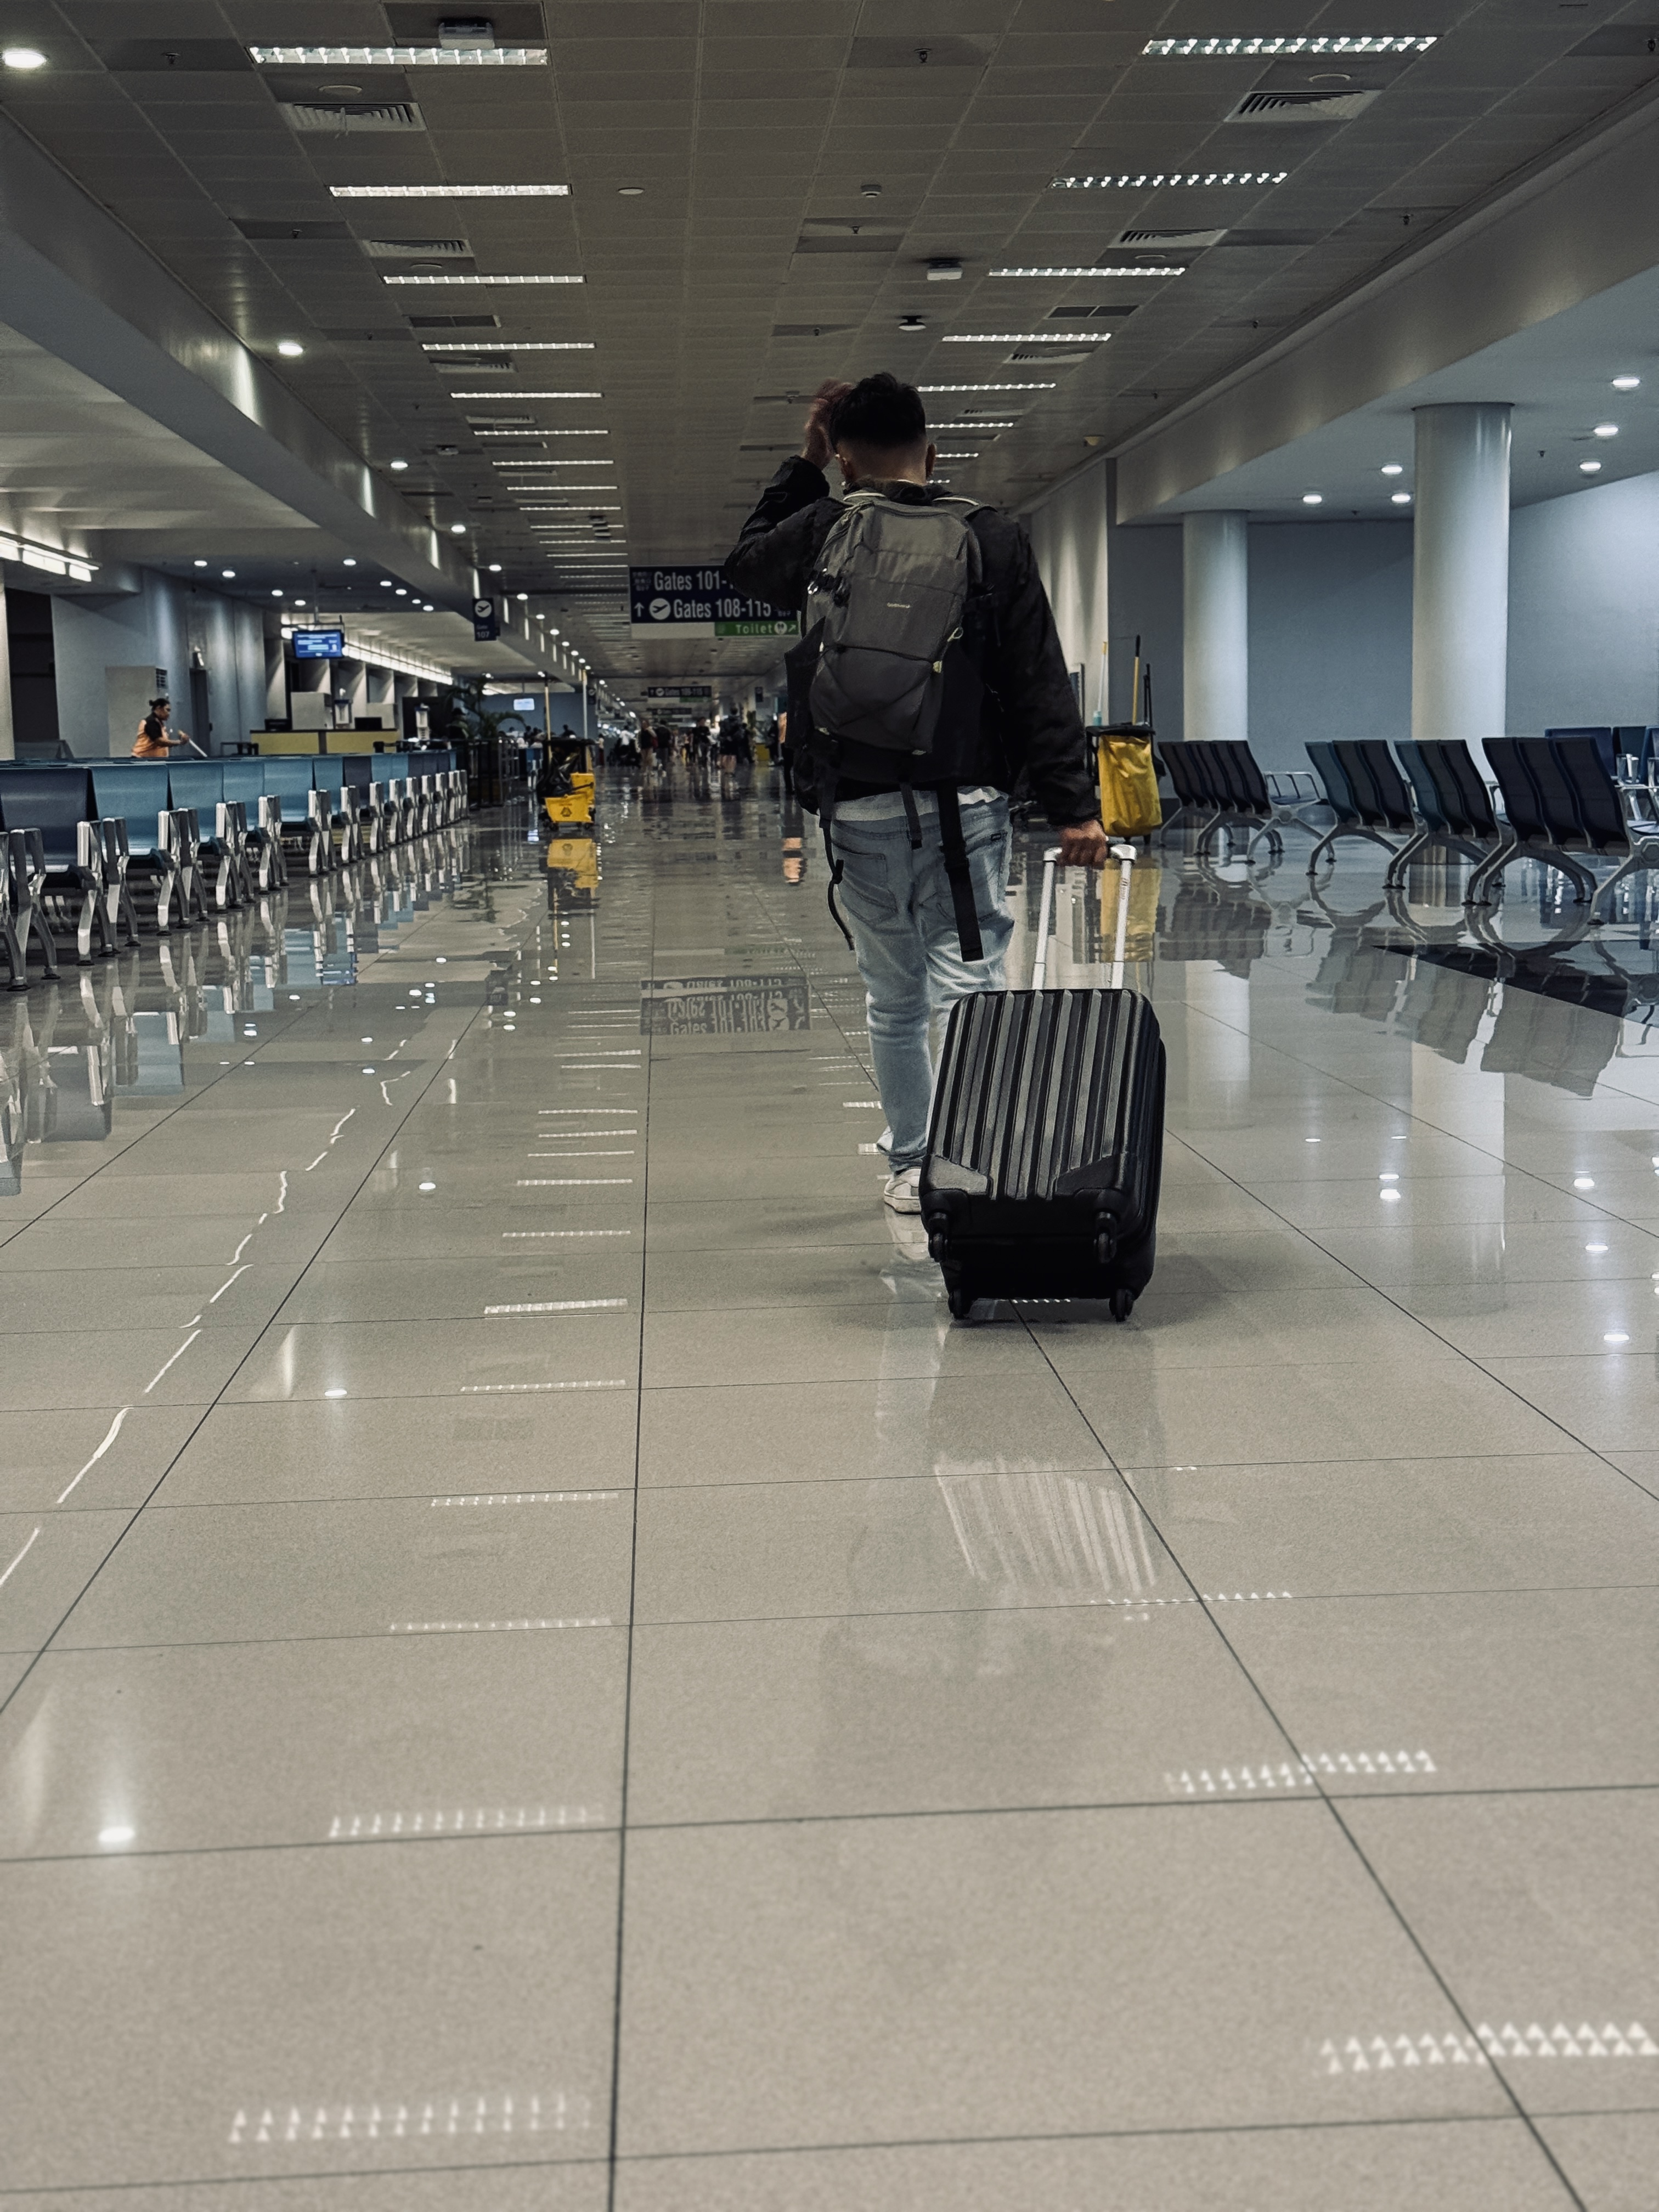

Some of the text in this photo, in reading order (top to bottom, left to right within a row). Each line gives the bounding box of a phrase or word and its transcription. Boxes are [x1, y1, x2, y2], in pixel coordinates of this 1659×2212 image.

[654, 571, 733, 591] Gates 101-
[674, 599, 771, 618] Gates 108-115
[736, 623, 772, 634] Toilet
